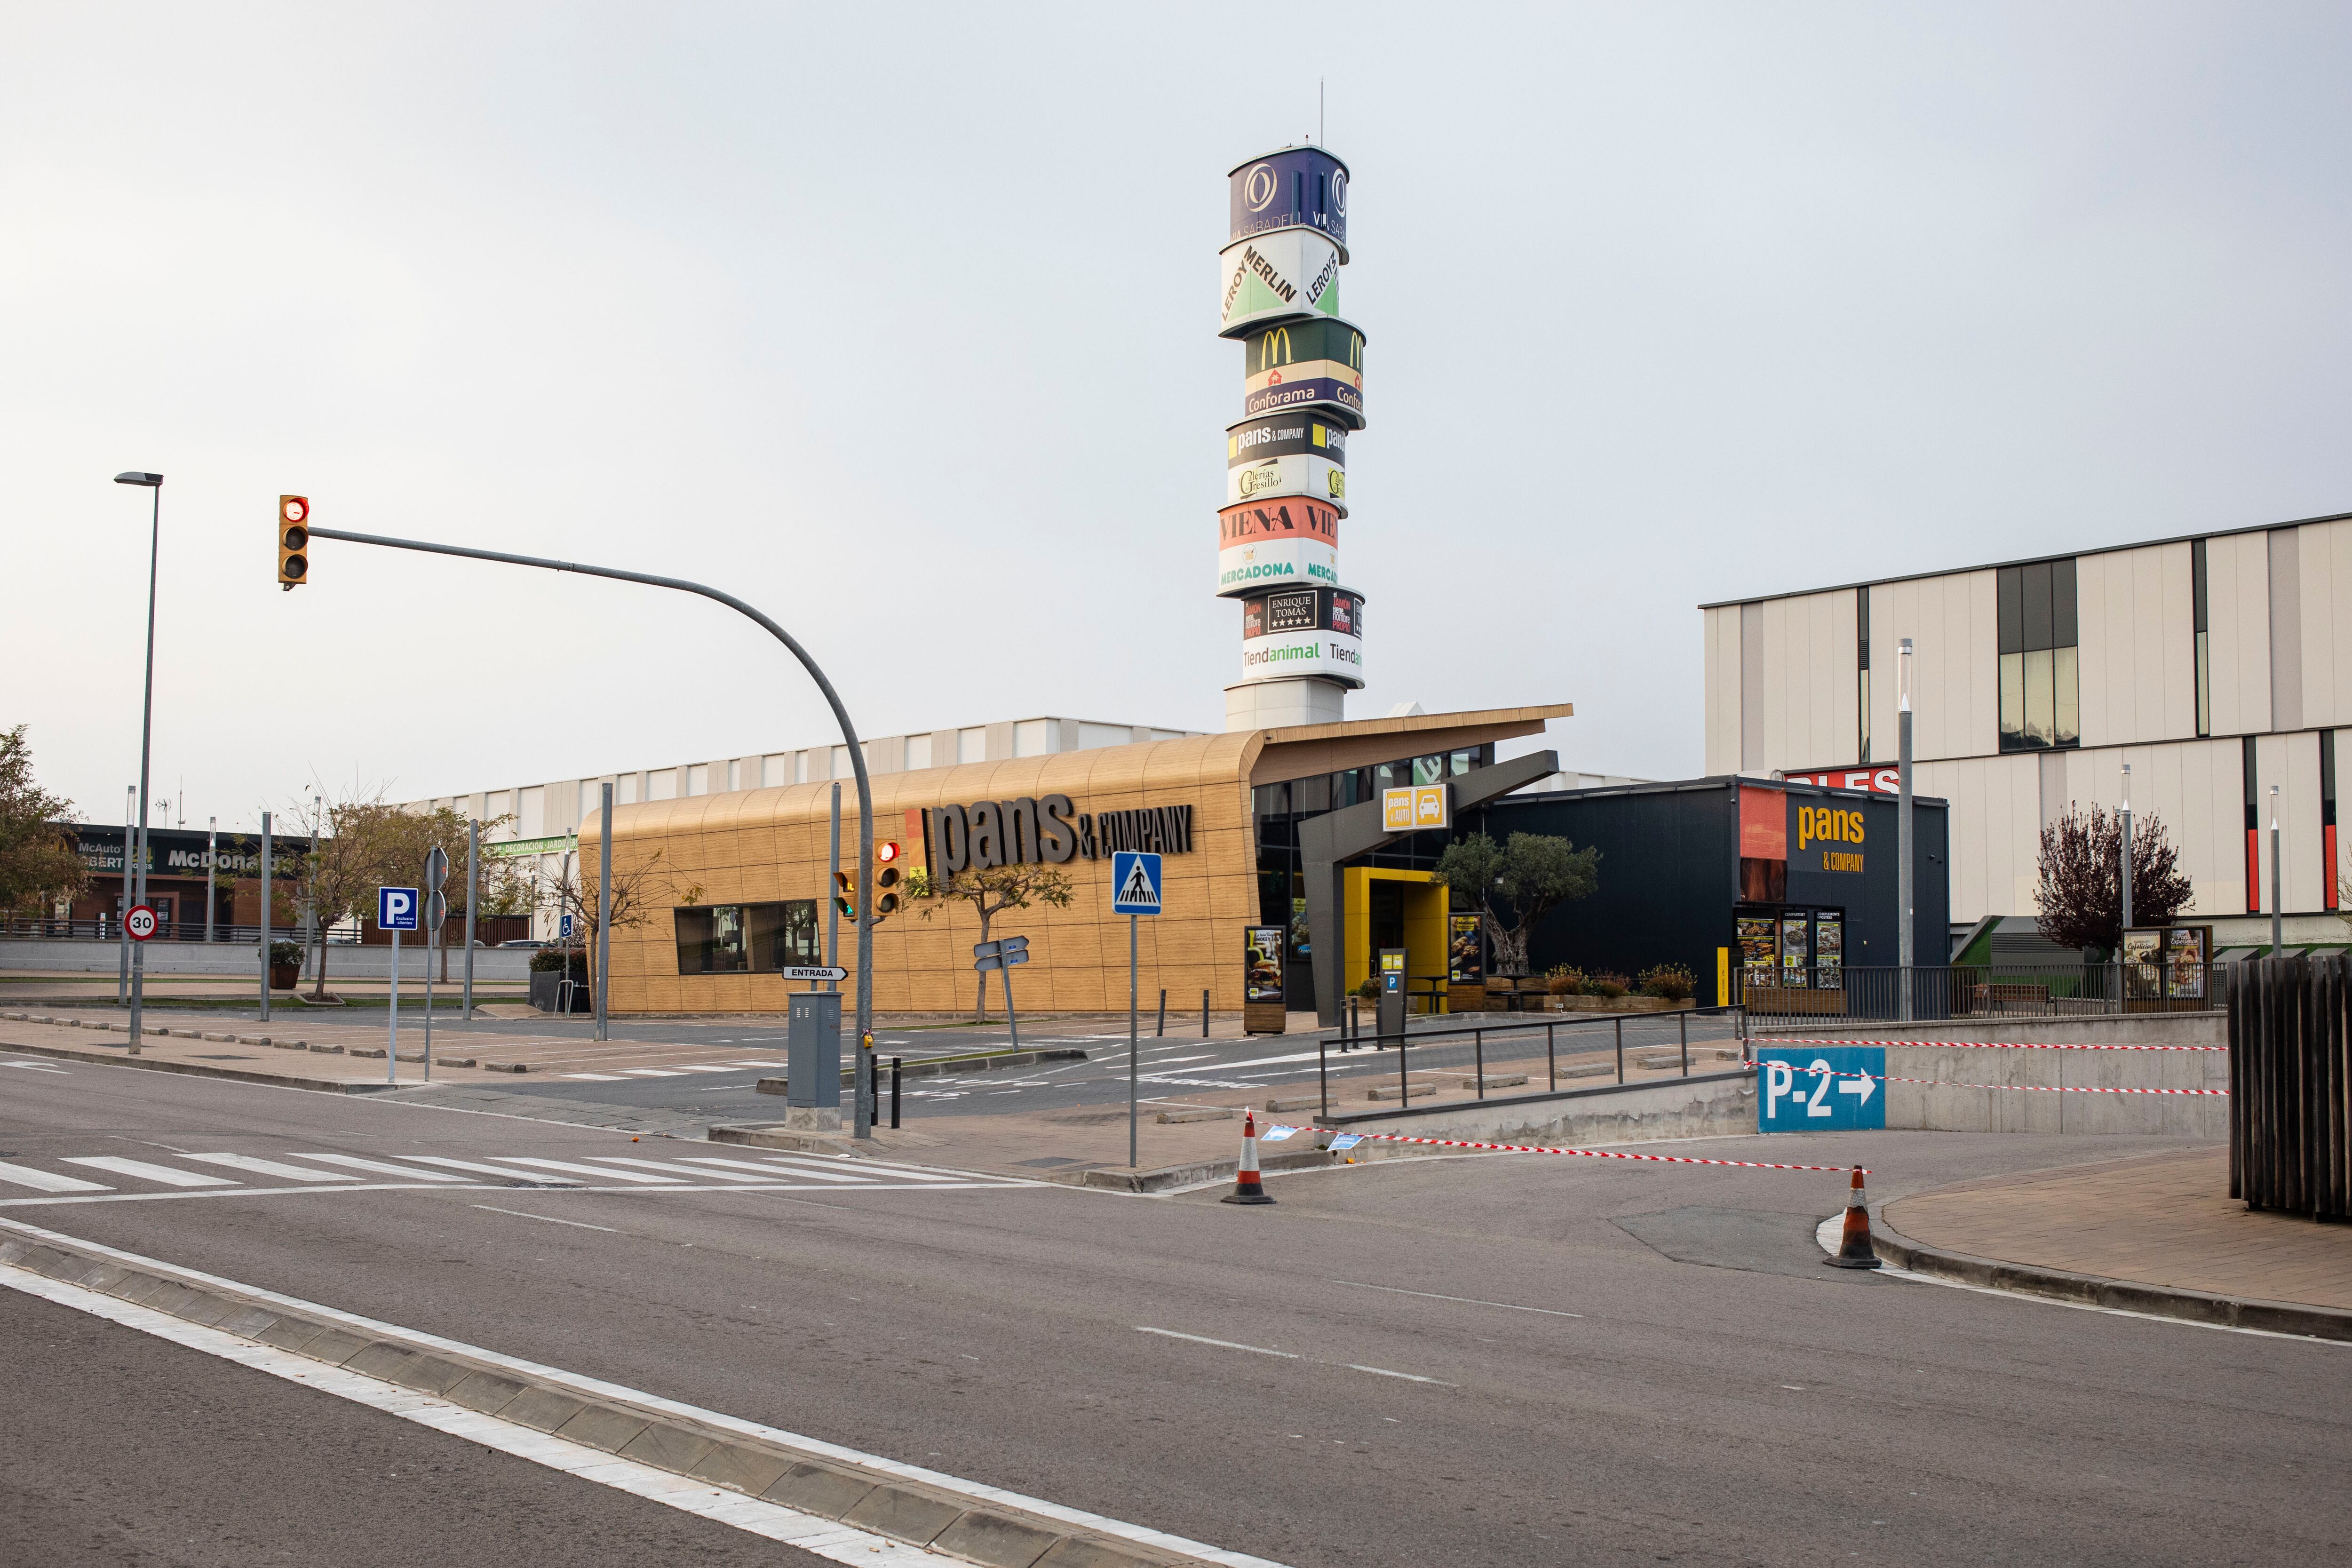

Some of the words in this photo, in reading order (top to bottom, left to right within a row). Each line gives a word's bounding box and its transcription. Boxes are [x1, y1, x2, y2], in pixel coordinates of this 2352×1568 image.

[1222, 259, 1247, 322] LEROY
[1244, 245, 1297, 303] MERLIN
[1306, 258, 1332, 305] LEROY
[1249, 387, 1315, 413] Conforama
[1238, 427, 1271, 455] pans
[1272, 430, 1276, 441] &
[1277, 427, 1304, 440] COMPANY
[1327, 428, 1345, 452] pans
[1220, 506, 1295, 541] VIENA
[1221, 562, 1294, 587] MERCADONA
[1272, 597, 1311, 608] ENRIQUE
[1275, 607, 1306, 618] TOMAS
[1333, 597, 1350, 610] JAMÓN
[1246, 618, 1261, 629] nombre
[1333, 612, 1350, 624] nombre
[1333, 621, 1350, 633] PROPIO
[1246, 626, 1261, 637] PROPIO
[1244, 642, 1320, 667] Tiendanimal
[1388, 797, 1409, 810] pans
[1395, 809, 1410, 822] AUTO
[1798, 806, 1865, 851] pans
[506, 840, 543, 852] DECORACIÓN
[932, 794, 1075, 892] pans
[1078, 813, 1095, 860] &
[1097, 804, 1192, 859] COMPANY
[1823, 852, 1830, 871] &
[1831, 852, 1864, 873] COMPANY
[387, 892, 410, 924] P
[132, 917, 151, 929] 30
[1390, 977, 1395, 987] P
[1767, 1059, 1832, 1118] P-2
